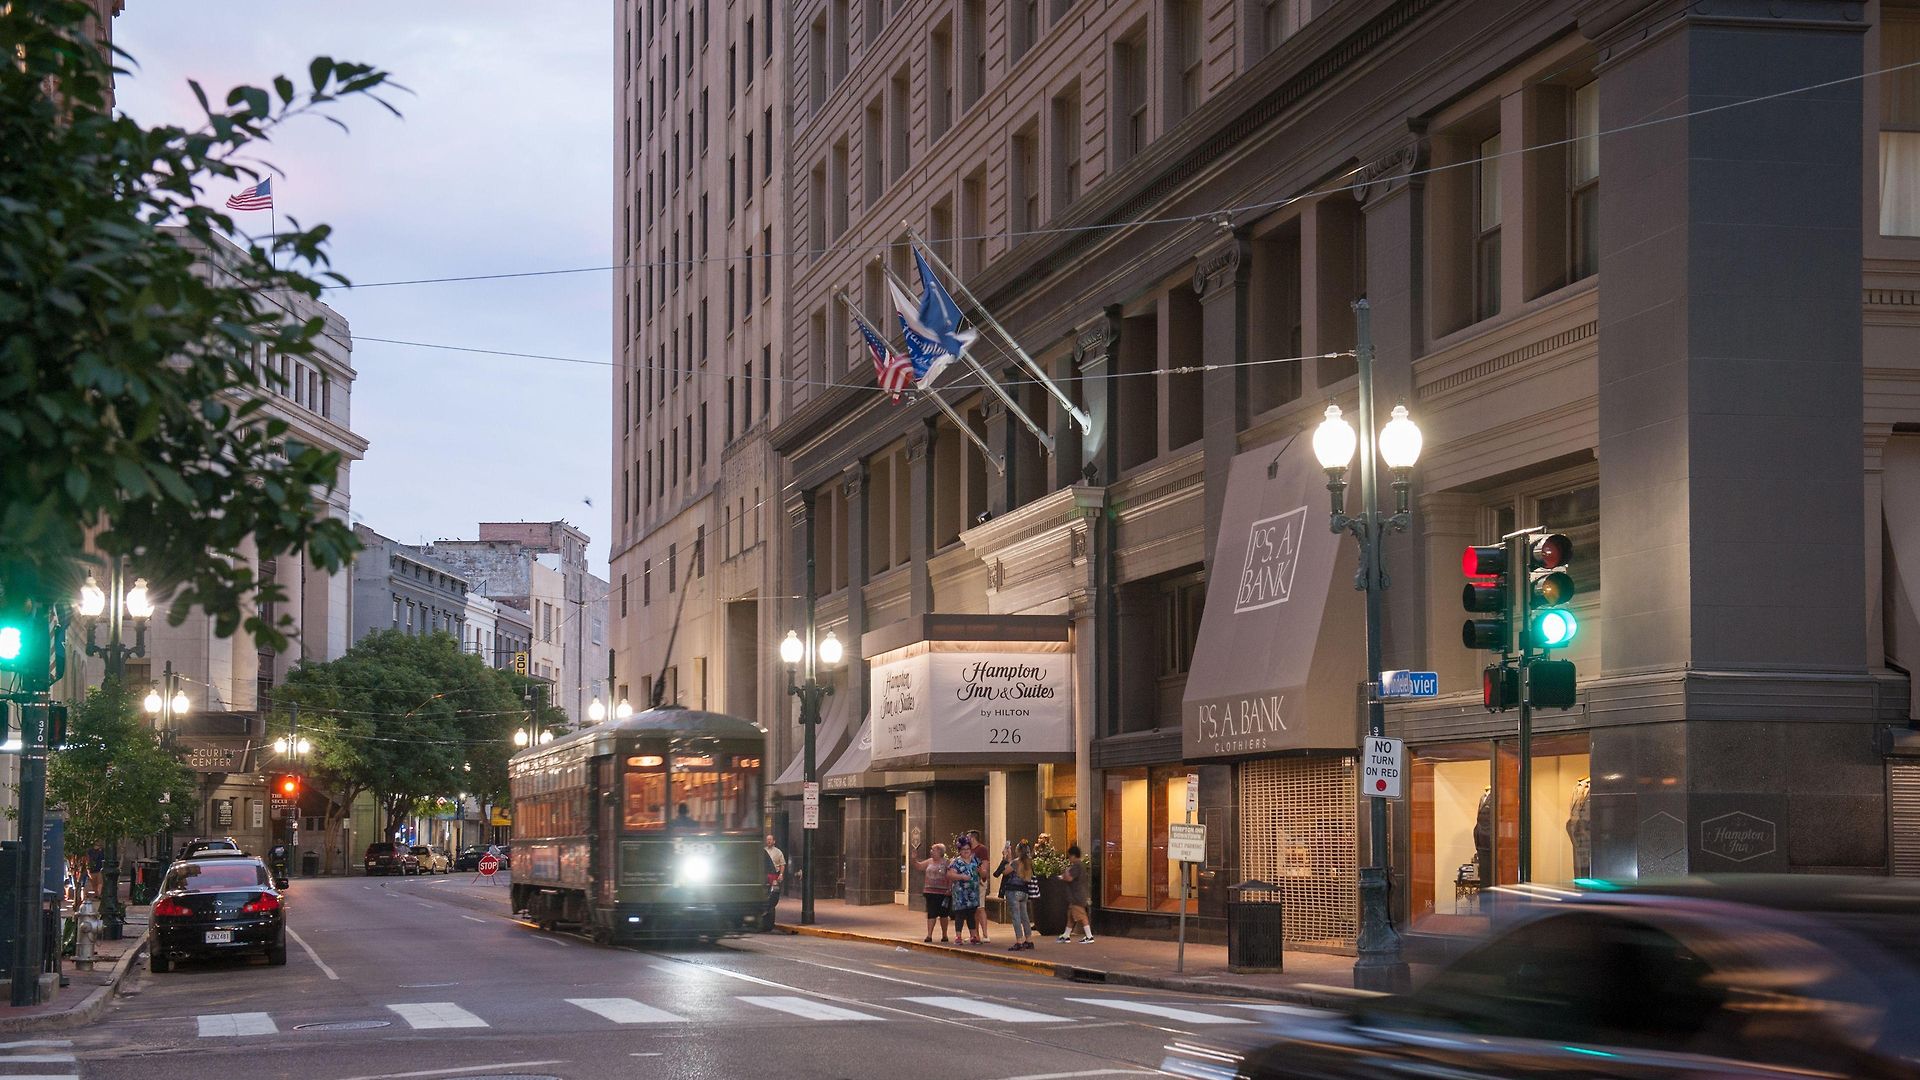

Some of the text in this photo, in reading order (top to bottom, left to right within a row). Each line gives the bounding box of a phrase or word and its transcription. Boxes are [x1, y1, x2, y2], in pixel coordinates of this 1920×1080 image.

[1240, 559, 1290, 603] BANK
[963, 661, 1046, 682] Hampton
[883, 671, 912, 697] Hampton
[957, 682, 1054, 700] Inn & Suites
[980, 709, 991, 717] by
[1220, 703, 1237, 736] A.
[1241, 696, 1287, 735] BANK
[989, 728, 1021, 744] 226
[1215, 738, 1267, 752] CLOTHIERS
[1375, 741, 1392, 753] NO
[191, 758, 231, 767] CENTER
[1372, 755, 1394, 765] TURN
[1366, 767, 1398, 778] ON RED
[1711, 826, 1769, 842] Hampton
[1723, 840, 1754, 854] Inn
[480, 861, 497, 870] STOP
